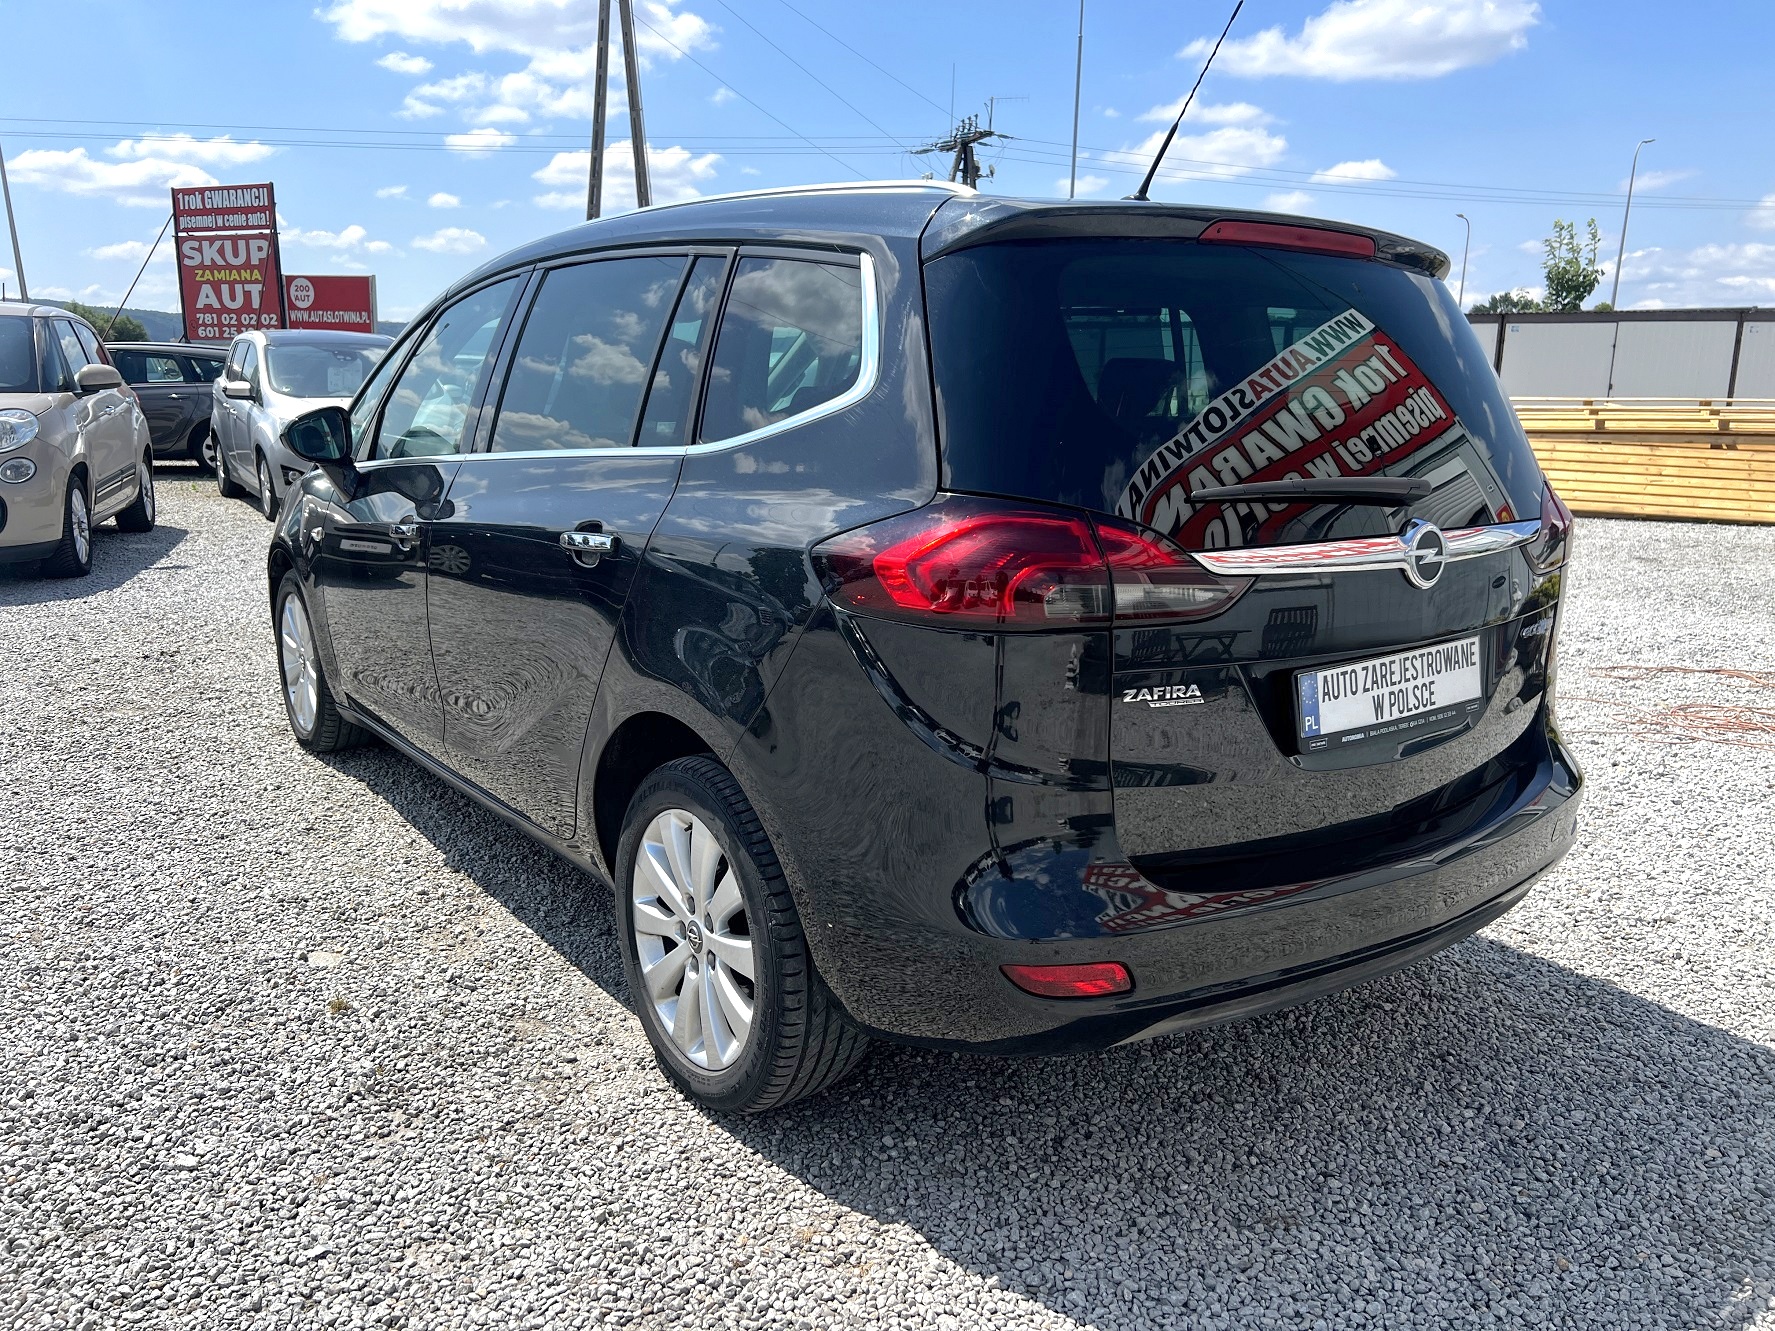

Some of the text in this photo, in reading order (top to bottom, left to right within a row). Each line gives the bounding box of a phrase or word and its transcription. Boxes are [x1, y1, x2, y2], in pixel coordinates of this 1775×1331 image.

[204, 187, 269, 209] GWARANCJI
[179, 213, 216, 230] pisemnej
[216, 216, 224, 227] w
[224, 211, 247, 227] cenie
[182, 239, 271, 266] SKUP
[195, 269, 262, 281] ZAMIANA
[196, 283, 266, 310] AUT
[294, 284, 310, 293] 200
[294, 294, 311, 303] AUT
[196, 313, 278, 325] 781 02 02 02
[289, 309, 371, 324] WWW.AUTASLOTWINA.PL
[197, 326, 220, 338] 601
[222, 327, 238, 338] 25
[1321, 641, 1477, 704] AUTO ZAREJESTROWANE
[1122, 683, 1202, 703] ZAFIRA
[1372, 680, 1436, 721] W POLSCE
[1304, 715, 1319, 732] PL
